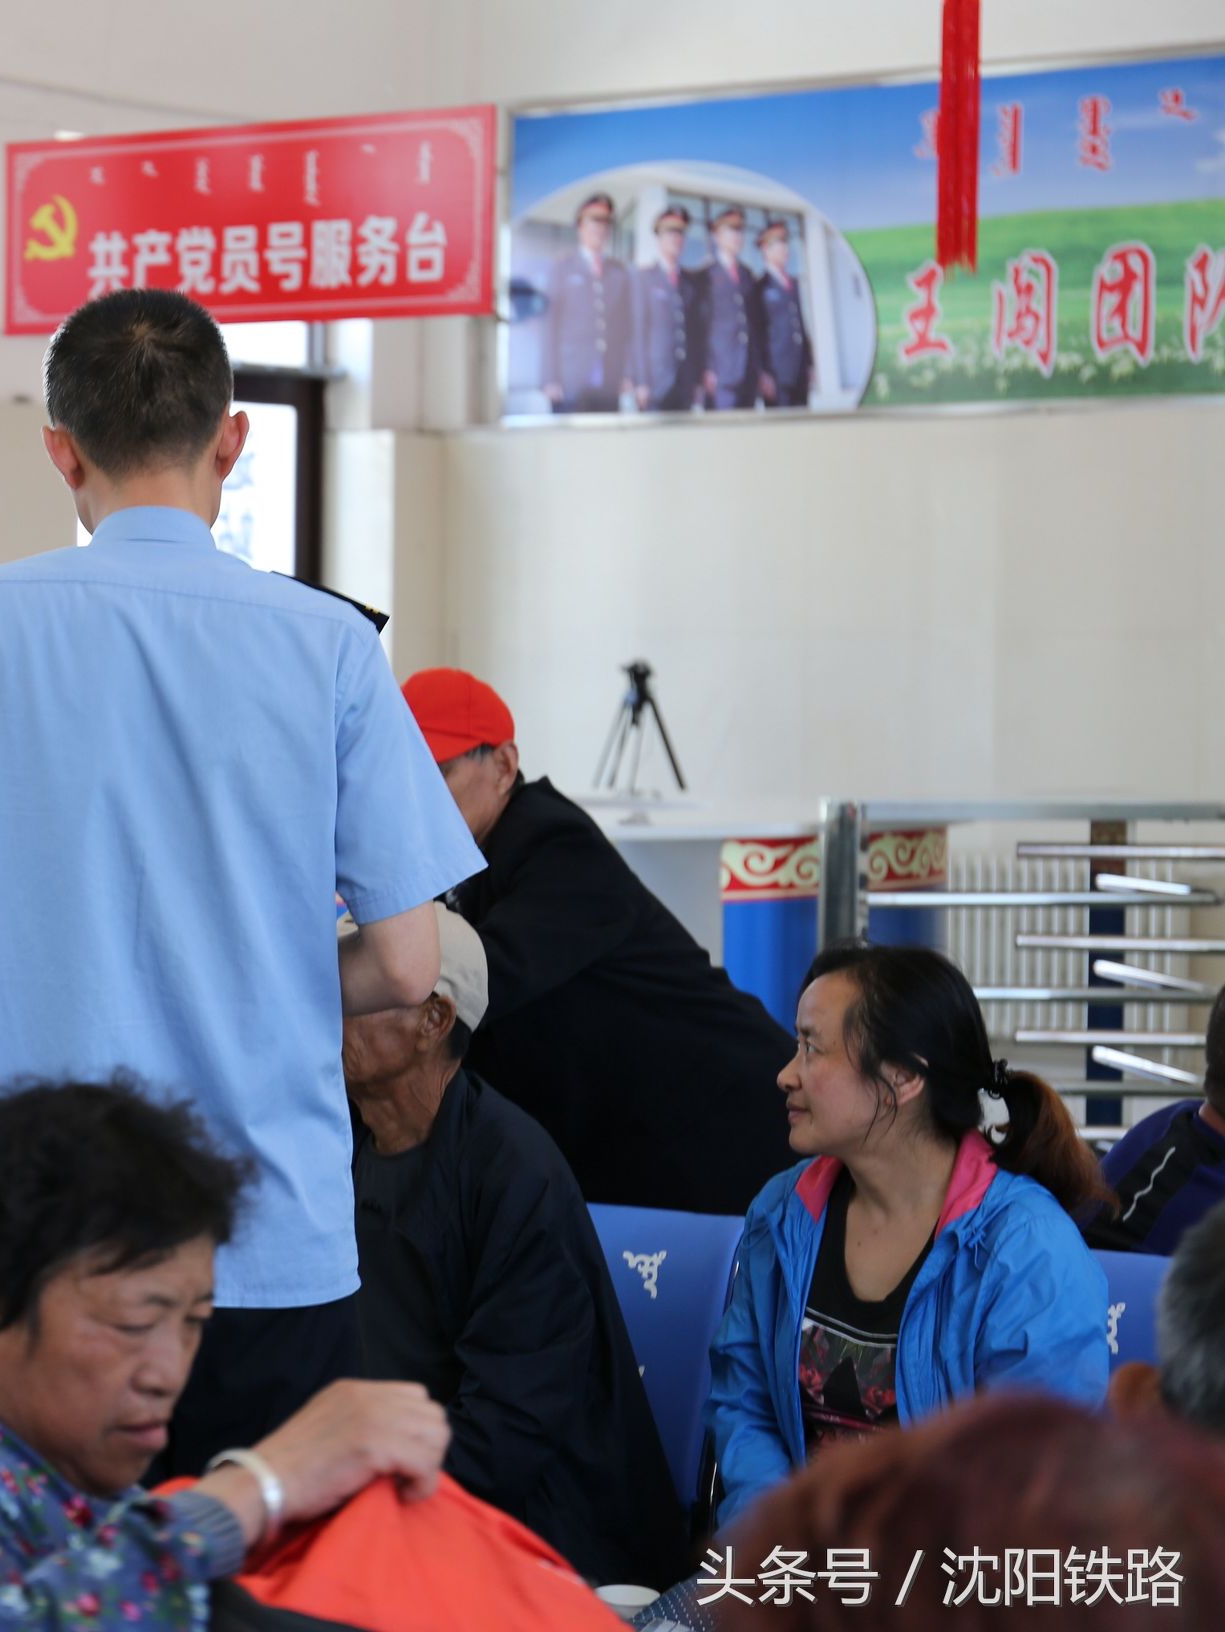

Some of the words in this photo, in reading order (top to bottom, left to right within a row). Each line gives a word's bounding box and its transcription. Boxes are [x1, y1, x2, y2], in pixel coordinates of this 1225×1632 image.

[87, 212, 447, 300] 共产党员号服务台
